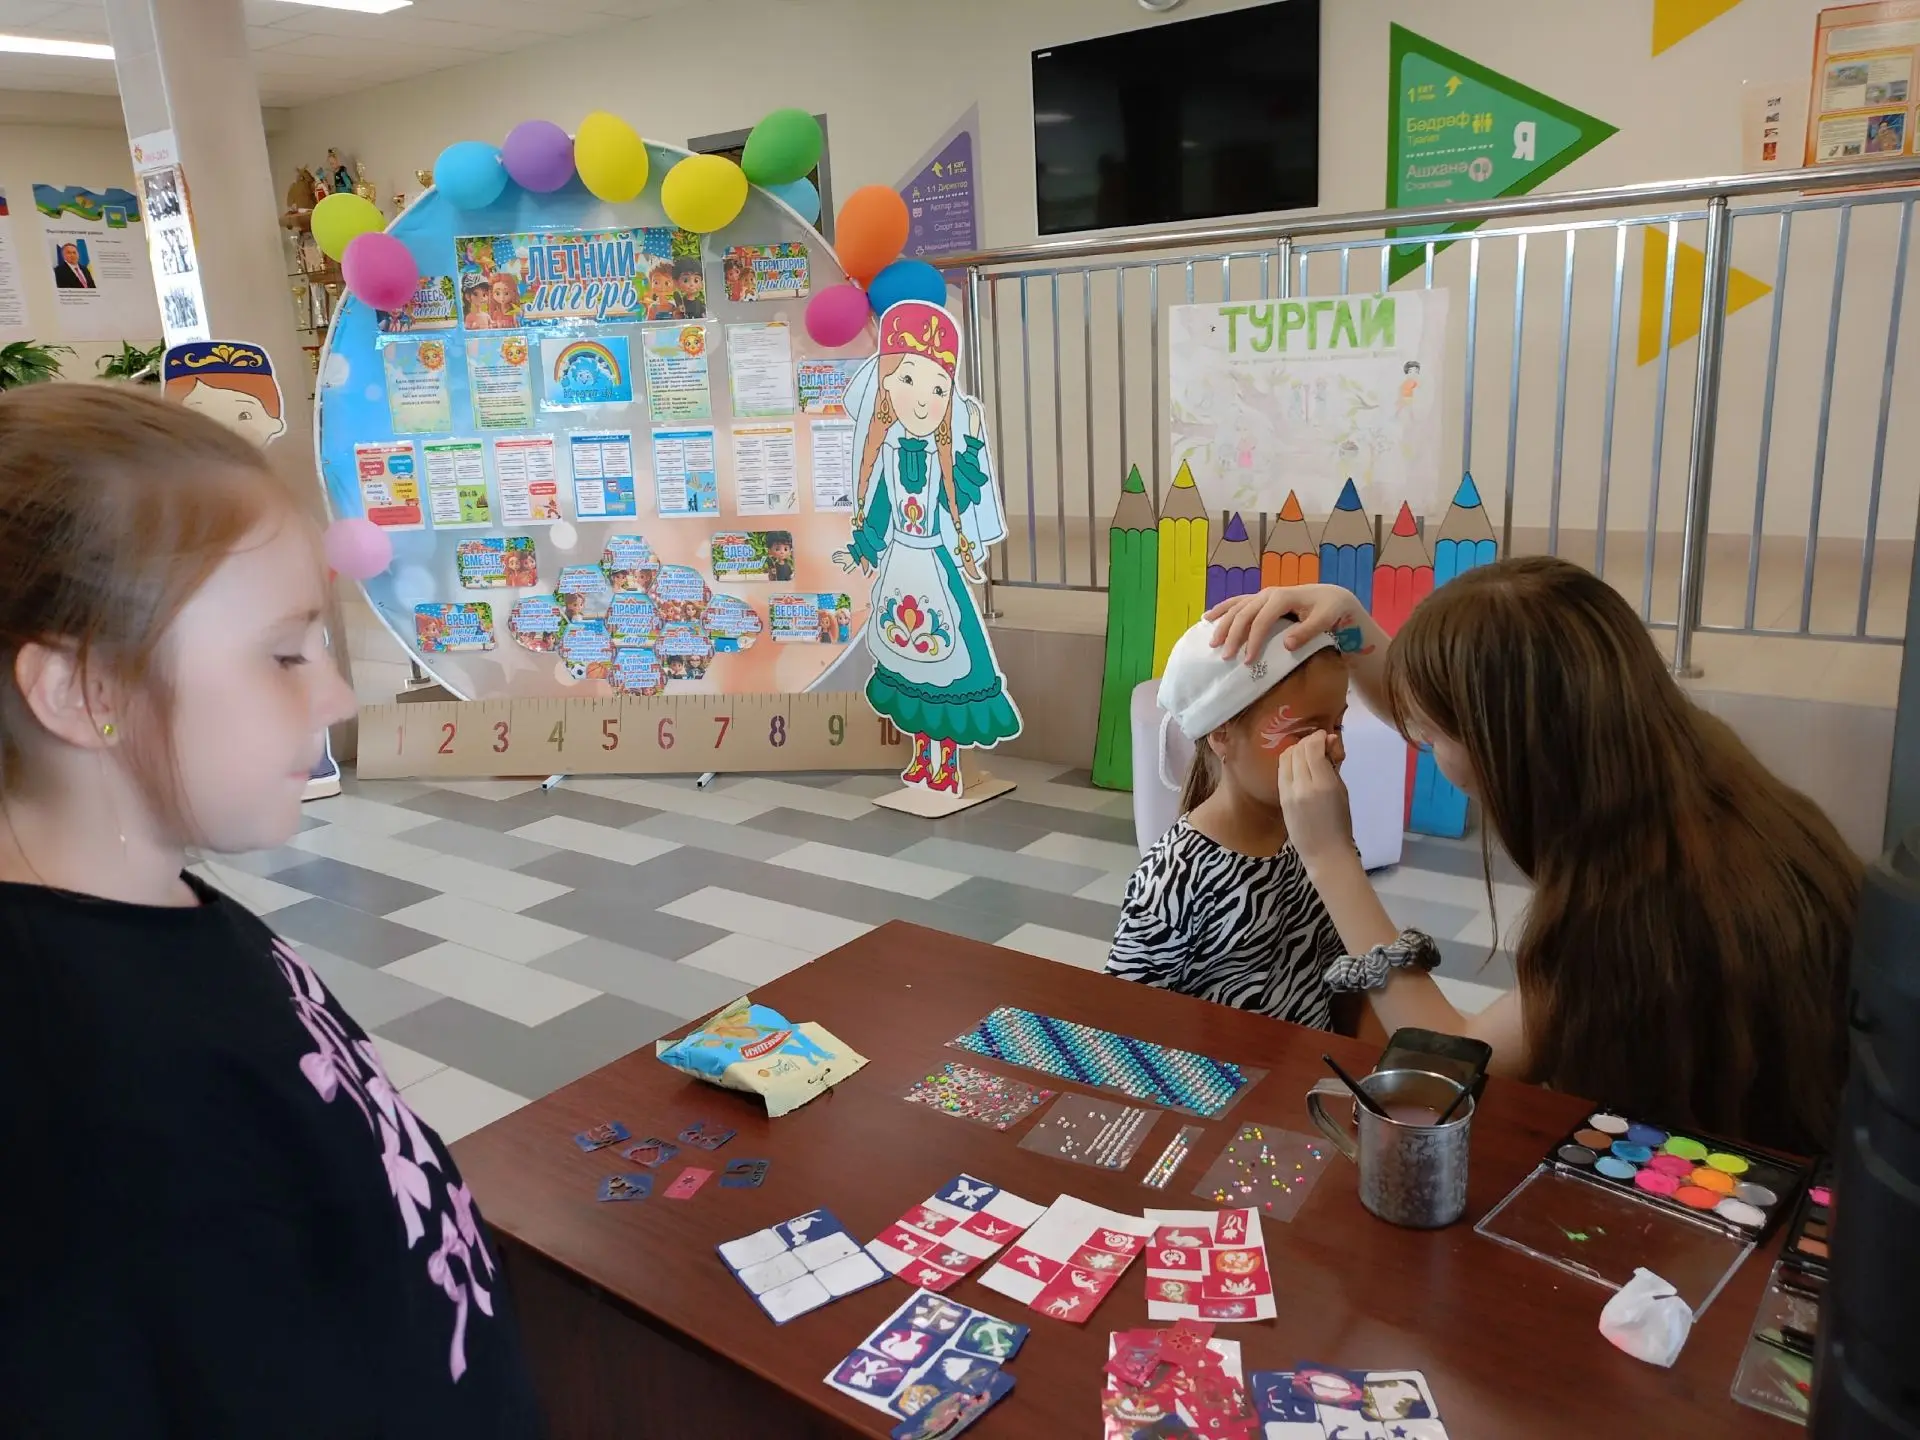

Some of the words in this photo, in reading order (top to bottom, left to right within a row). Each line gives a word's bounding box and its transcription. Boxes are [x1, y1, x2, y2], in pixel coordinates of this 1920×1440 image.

[1408, 88, 1415, 103] 1
[1512, 121, 1537, 162] Я
[947, 162, 952, 176] 1
[1405, 160, 1468, 179] Ашханә
[527, 233, 636, 282] ЛЕТНИЙ
[752, 258, 806, 271] ТЕРРИТОРИЯ
[413, 289, 445, 303] ЗДЕСЬ
[525, 281, 638, 320] лагерь
[809, 372, 846, 386] ЛАГЕРЕ
[723, 544, 755, 559] ЗДЕСЬ
[463, 552, 502, 567] ВМЕСТЕ
[715, 556, 766, 571] интересно!
[613, 603, 653, 615] ПРАВИЛА
[775, 605, 817, 617] ВЕСЕЛЬЕ
[446, 613, 478, 626] ВРЕМЯ
[397, 725, 403, 755] 1
[438, 723, 456, 754] 2
[492, 721, 509, 753] 3
[547, 720, 564, 752] 4
[601, 719, 619, 751] 5
[657, 718, 675, 750] 6
[714, 716, 730, 749] 7
[769, 715, 786, 748] 8
[828, 714, 845, 746] 9
[877, 717, 901, 746] 10
